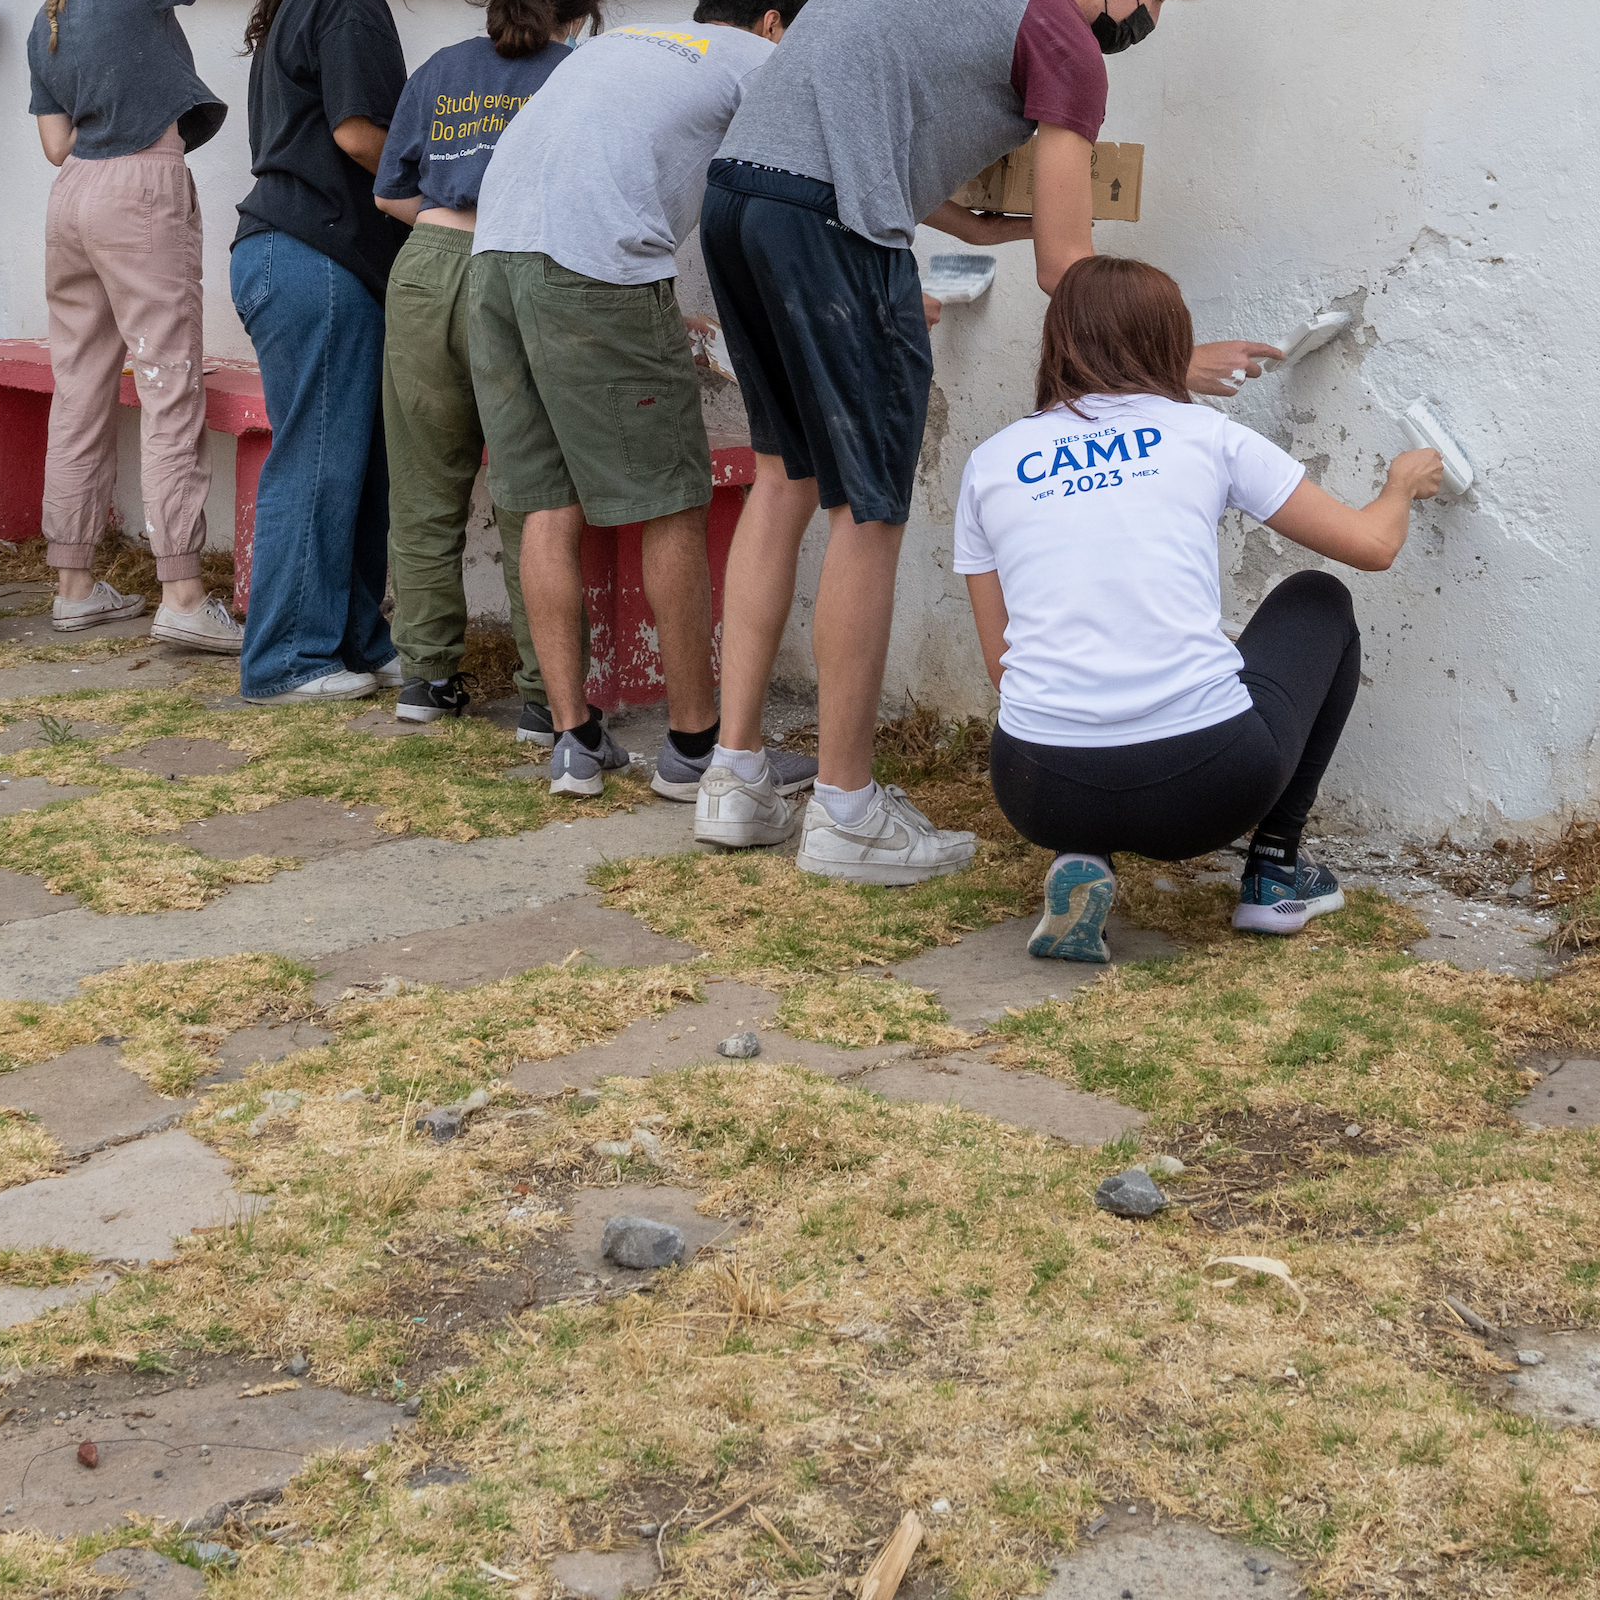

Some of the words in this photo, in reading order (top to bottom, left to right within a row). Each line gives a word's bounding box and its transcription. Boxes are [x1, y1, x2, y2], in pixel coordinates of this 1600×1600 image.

[624, 34, 701, 64] SUCCESS
[435, 90, 481, 116] Study
[431, 120, 454, 141] Do
[1053, 435, 1080, 446] TRES
[1082, 427, 1117, 440] SOLES
[1017, 427, 1162, 484] CAMP
[1031, 489, 1055, 501] VER
[1062, 469, 1123, 497] 2023
[1132, 468, 1160, 478] MEX
[1255, 844, 1286, 859] PUMA
